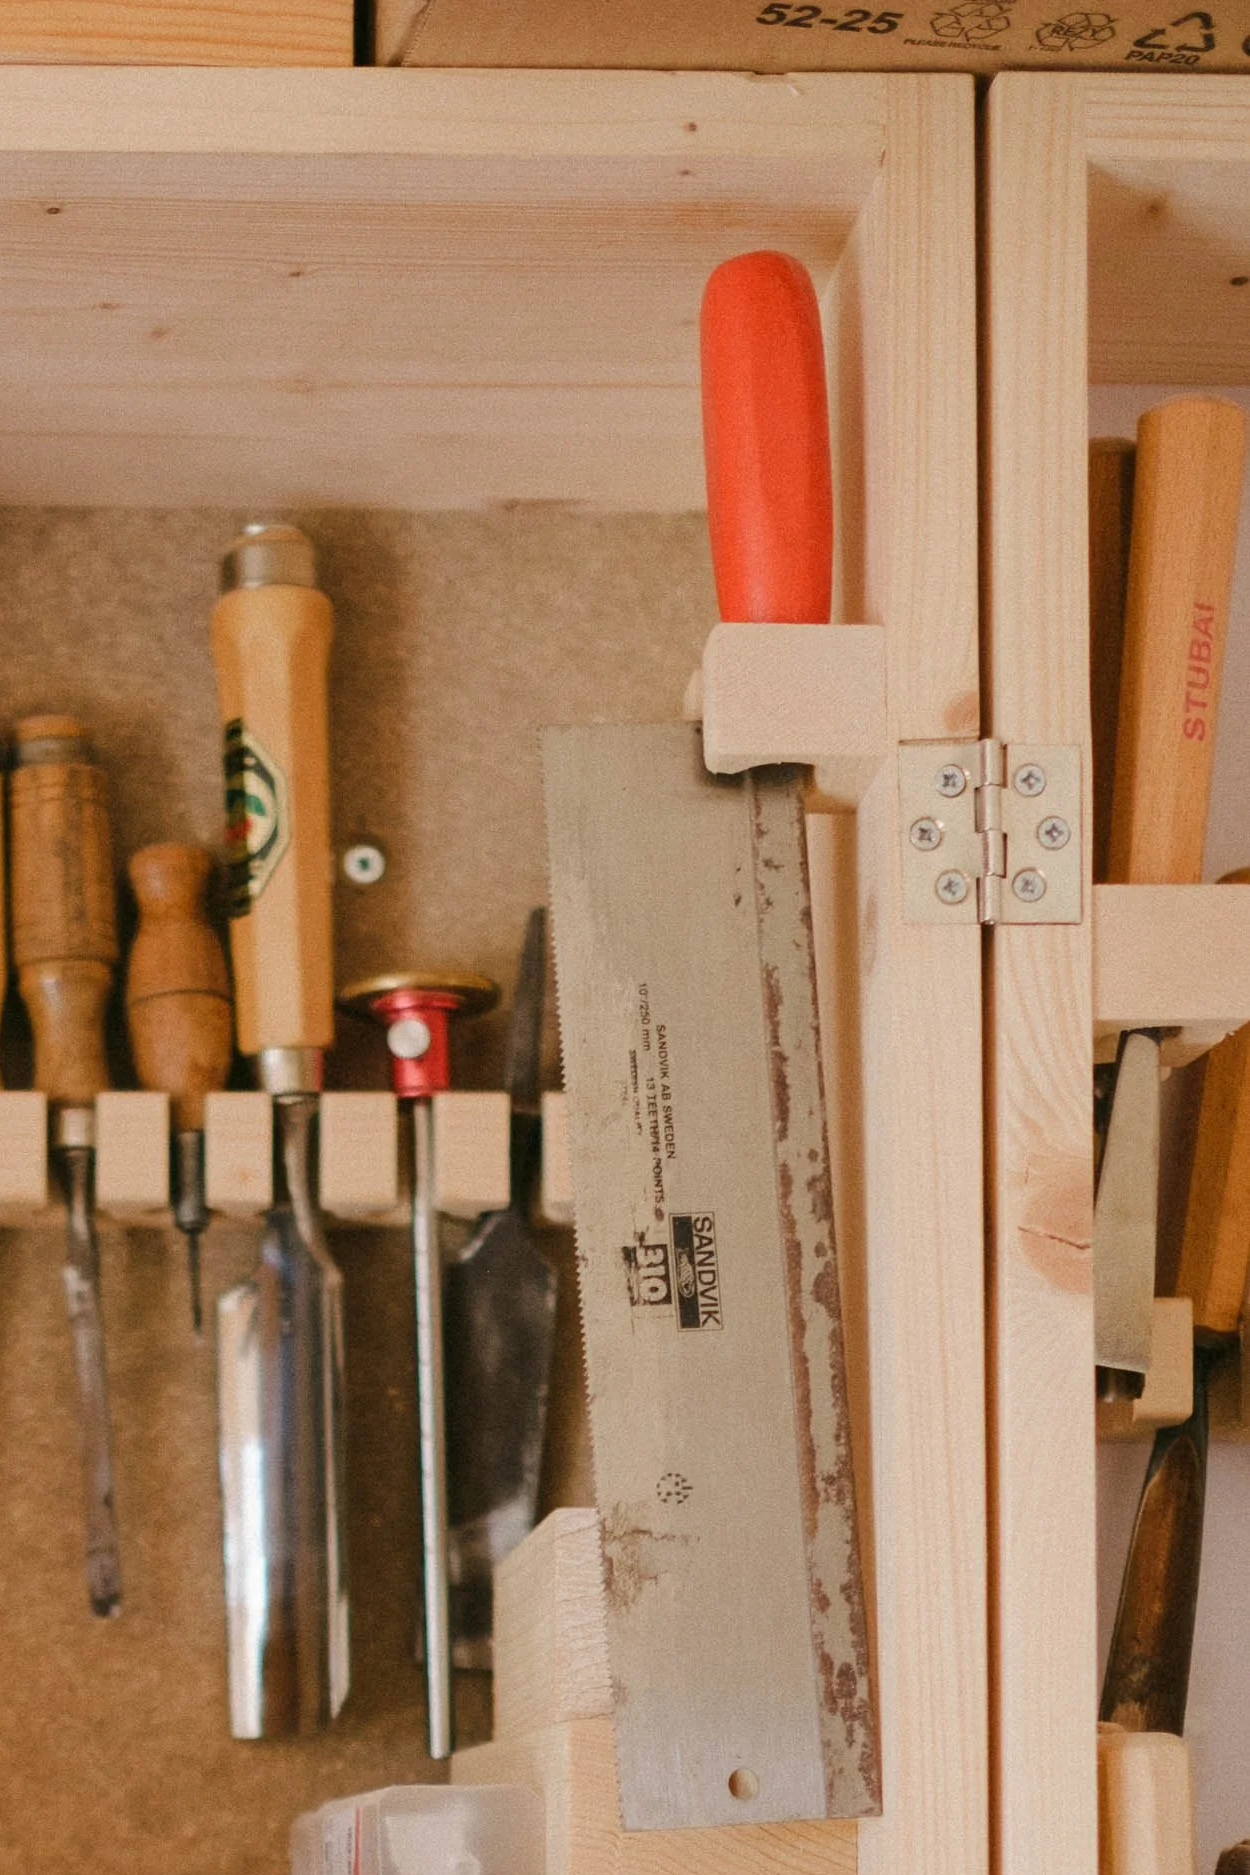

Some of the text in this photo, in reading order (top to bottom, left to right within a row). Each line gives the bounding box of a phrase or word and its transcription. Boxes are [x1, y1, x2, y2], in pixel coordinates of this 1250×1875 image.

[756, 3, 904, 34] 52-25
[1125, 50, 1199, 65] PAP20
[1183, 602, 1214, 741] STUBAI
[642, 1029, 651, 1052] mm
[646, 1077, 656, 1091] 13
[656, 1024, 676, 1160] SANDVIK AB SWEDEN
[693, 1216, 721, 1328] SANDVIK
